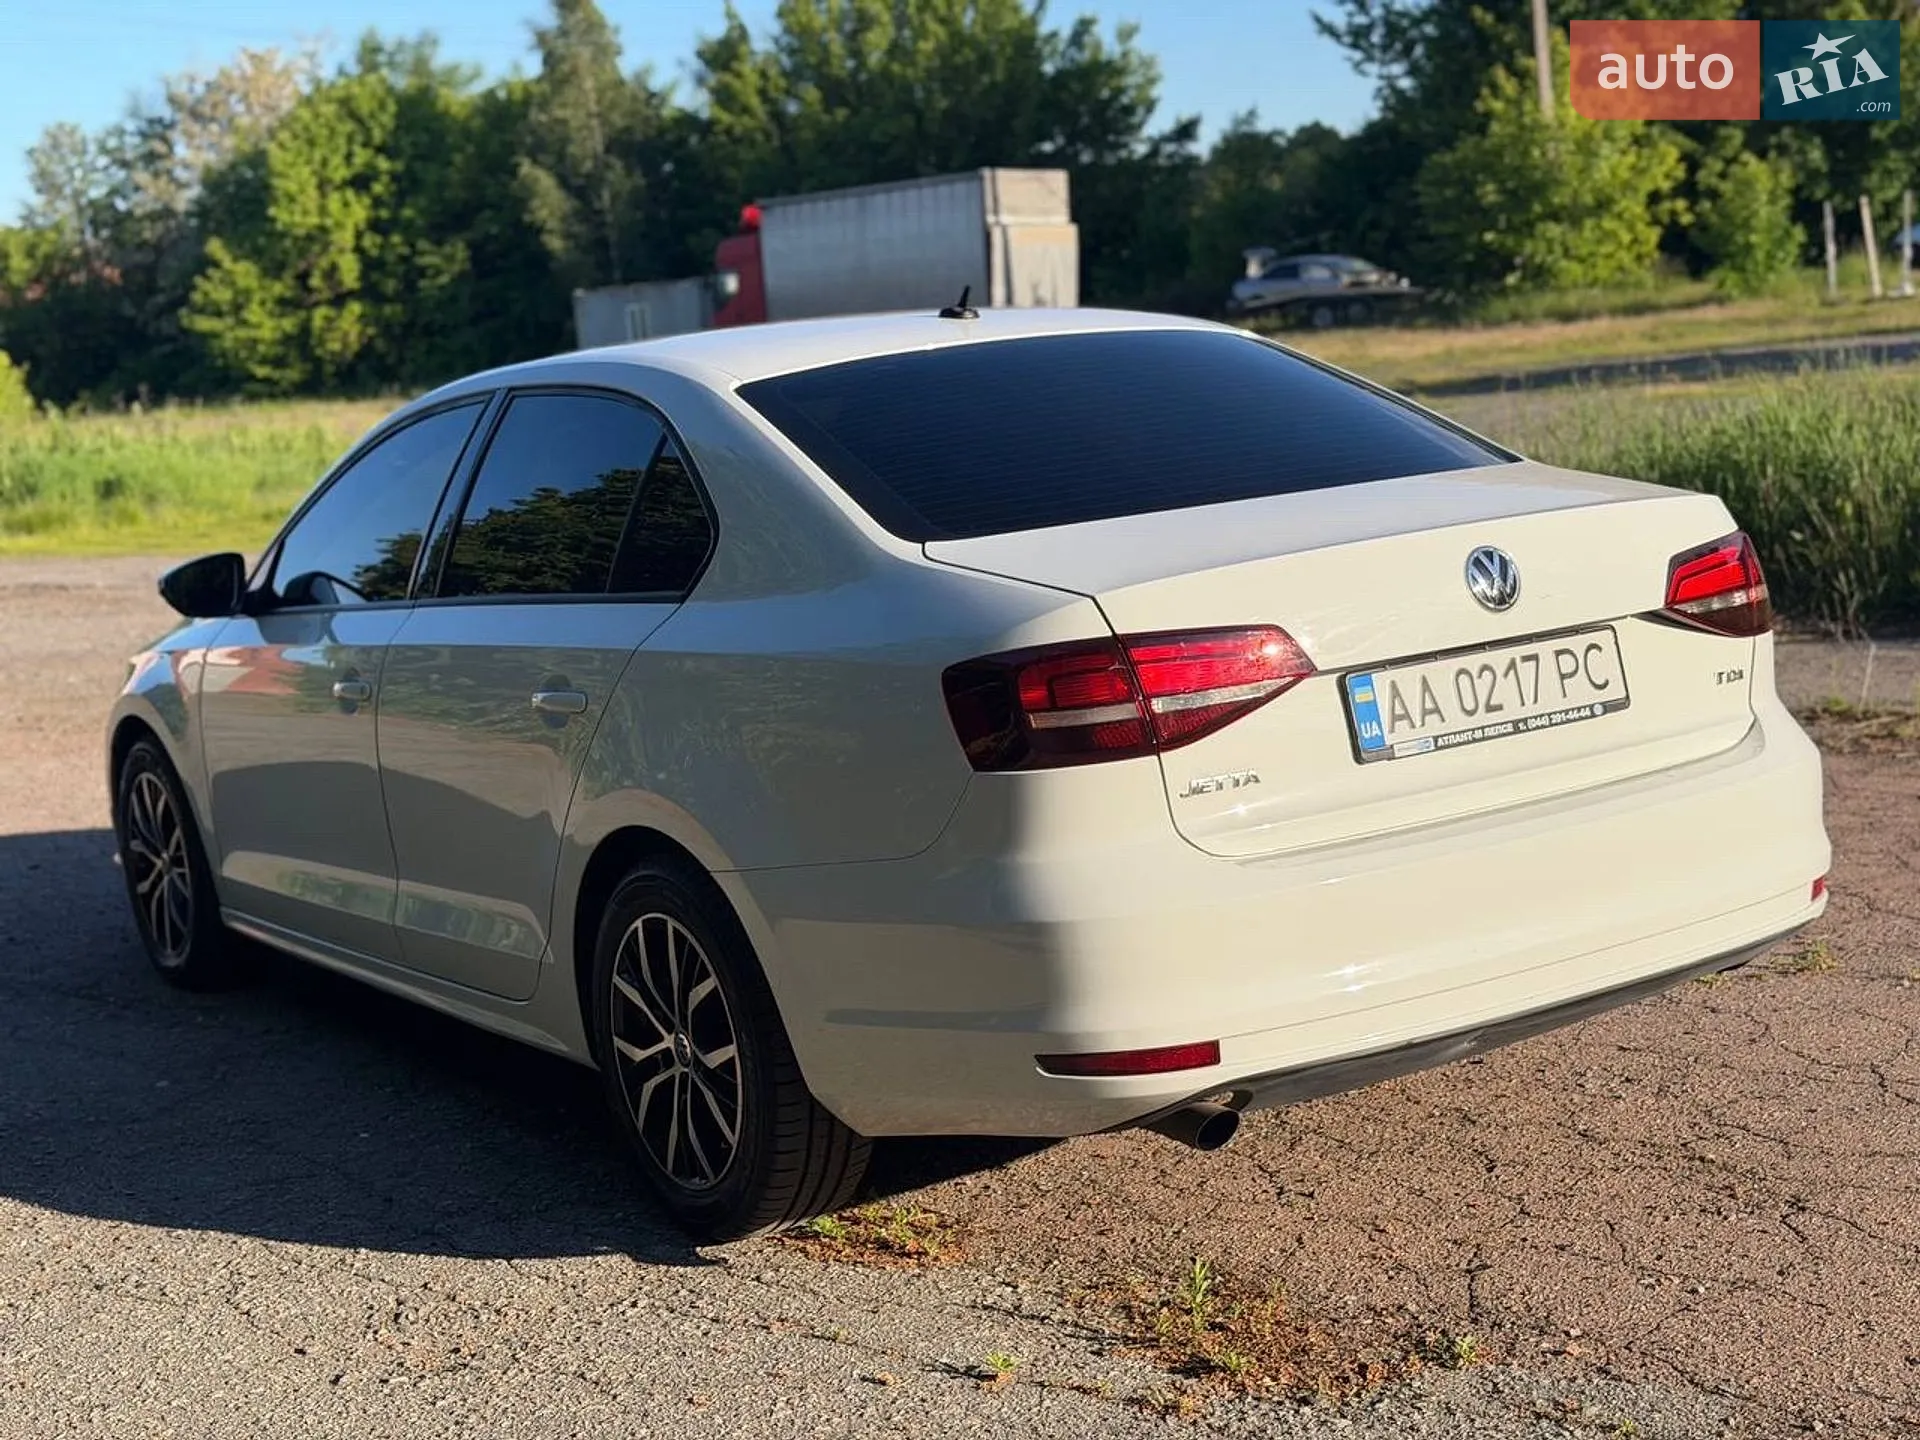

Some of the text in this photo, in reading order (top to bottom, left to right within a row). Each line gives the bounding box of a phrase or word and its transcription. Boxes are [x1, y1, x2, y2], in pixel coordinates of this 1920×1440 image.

[1388, 643, 1609, 734] AA 0217 PC
[1361, 720, 1381, 738] UA
[1527, 715, 1549, 729] (044)
[1179, 769, 1261, 798] JETTA
